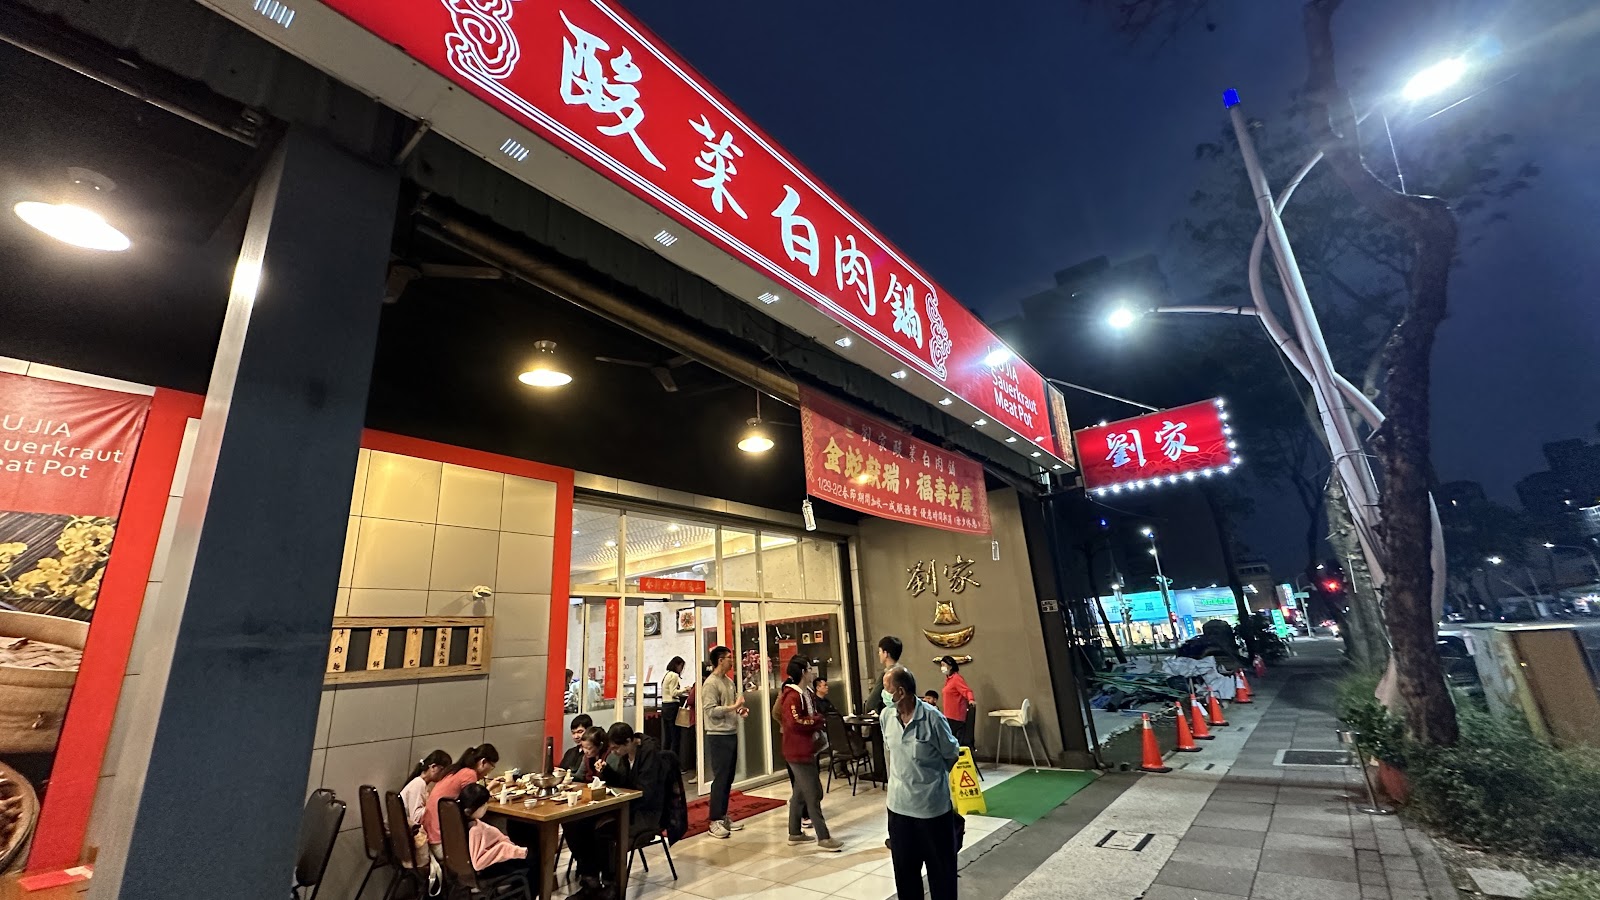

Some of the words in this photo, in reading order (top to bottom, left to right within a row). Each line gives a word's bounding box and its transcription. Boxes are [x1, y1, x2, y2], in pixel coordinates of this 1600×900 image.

[559, 9, 923, 349] 酸菜白肉鍋
[991, 366, 1038, 415] Sauerkraut
[994, 387, 1018, 419] Meat
[1018, 404, 1034, 429] Pot
[28, 418, 72, 438] JIA
[1105, 420, 1199, 468] 劉家
[0, 458, 36, 474] at
[42, 459, 90, 478] Pot
[3, 439, 124, 463] uerkraut
[861, 423, 956, 477] 劉家酸菜白肉鍋
[906, 554, 981, 597] 劉家
